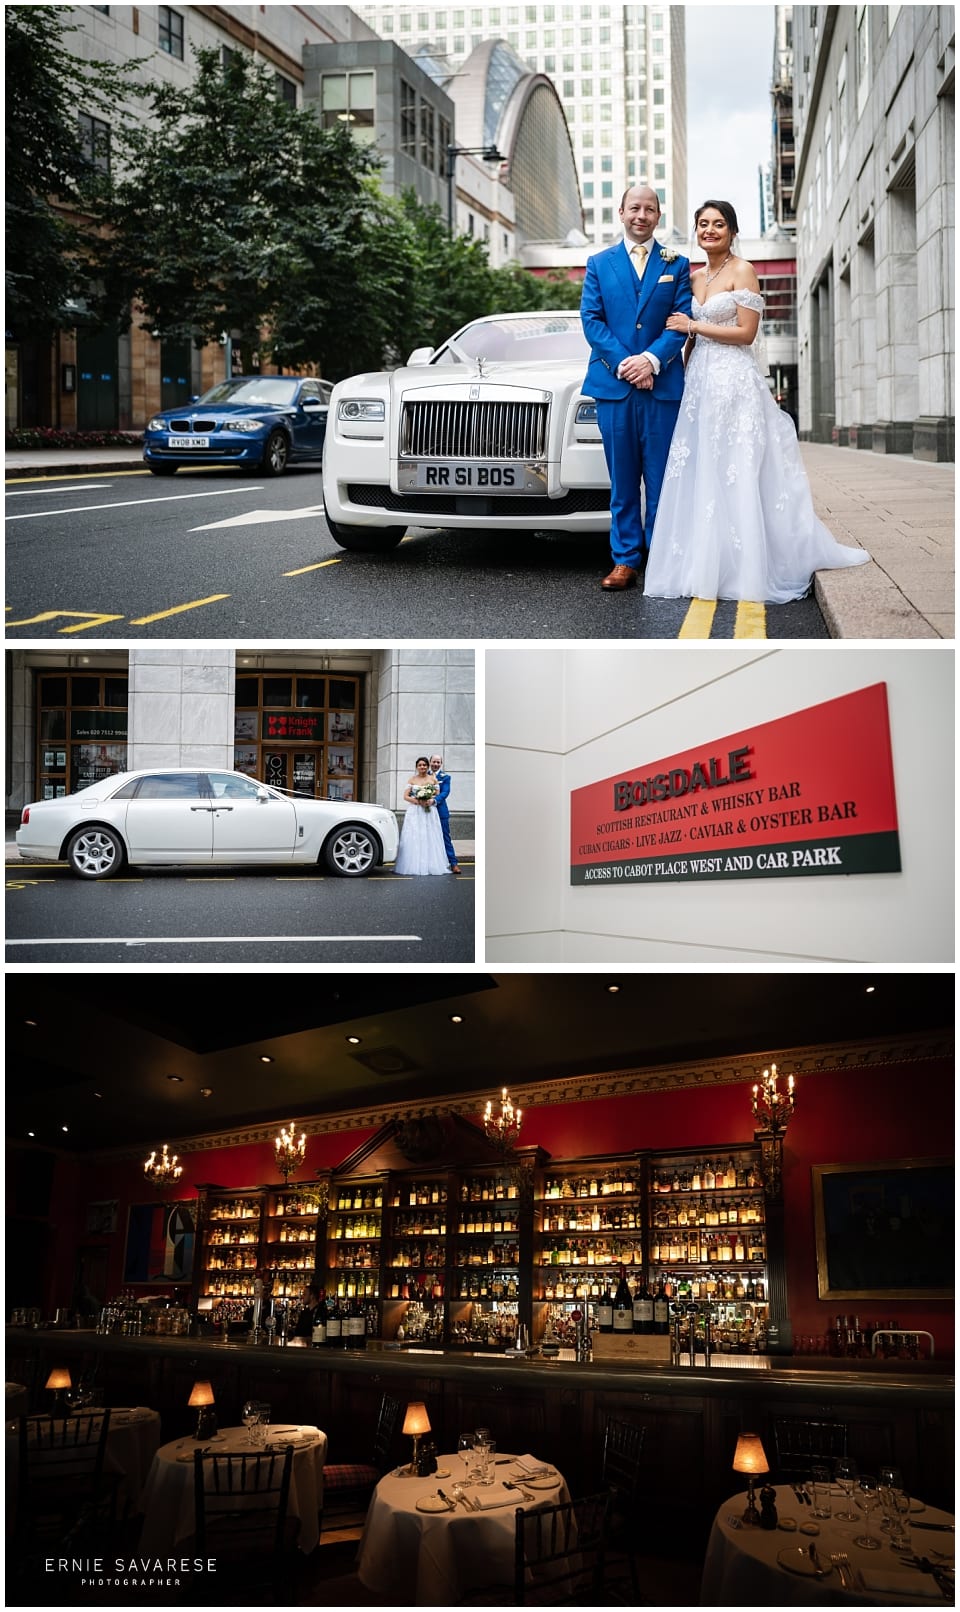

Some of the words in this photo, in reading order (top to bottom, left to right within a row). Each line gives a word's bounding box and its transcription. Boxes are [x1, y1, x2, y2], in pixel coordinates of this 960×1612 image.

[426, 466, 449, 485] RR
[477, 468, 515, 486] BOS
[288, 716, 318, 727] Knight
[288, 727, 313, 735] Frank
[614, 745, 753, 812] BOISDALE
[596, 818, 633, 835] SCOTTISH
[635, 804, 698, 828] RESTAURANT
[700, 802, 709, 815] &
[712, 790, 764, 812] WHISKY
[768, 782, 802, 802] BAR
[578, 842, 601, 855] CUBAN
[602, 838, 630, 853] CIGARS
[636, 834, 656, 848] LIVE
[659, 829, 682, 844] JAZZ
[689, 821, 734, 840] CAVIAR
[736, 819, 746, 834] &
[750, 808, 813, 832] OYSTER
[817, 801, 858, 822] BAR
[585, 866, 611, 880] ACCESS
[612, 866, 623, 878] TO
[624, 864, 653, 877] CABOT
[655, 861, 688, 875] PLACE
[690, 858, 723, 873] WEST
[724, 855, 753, 872] AND
[756, 852, 789, 869] CAR
[792, 846, 842, 867] PARK
